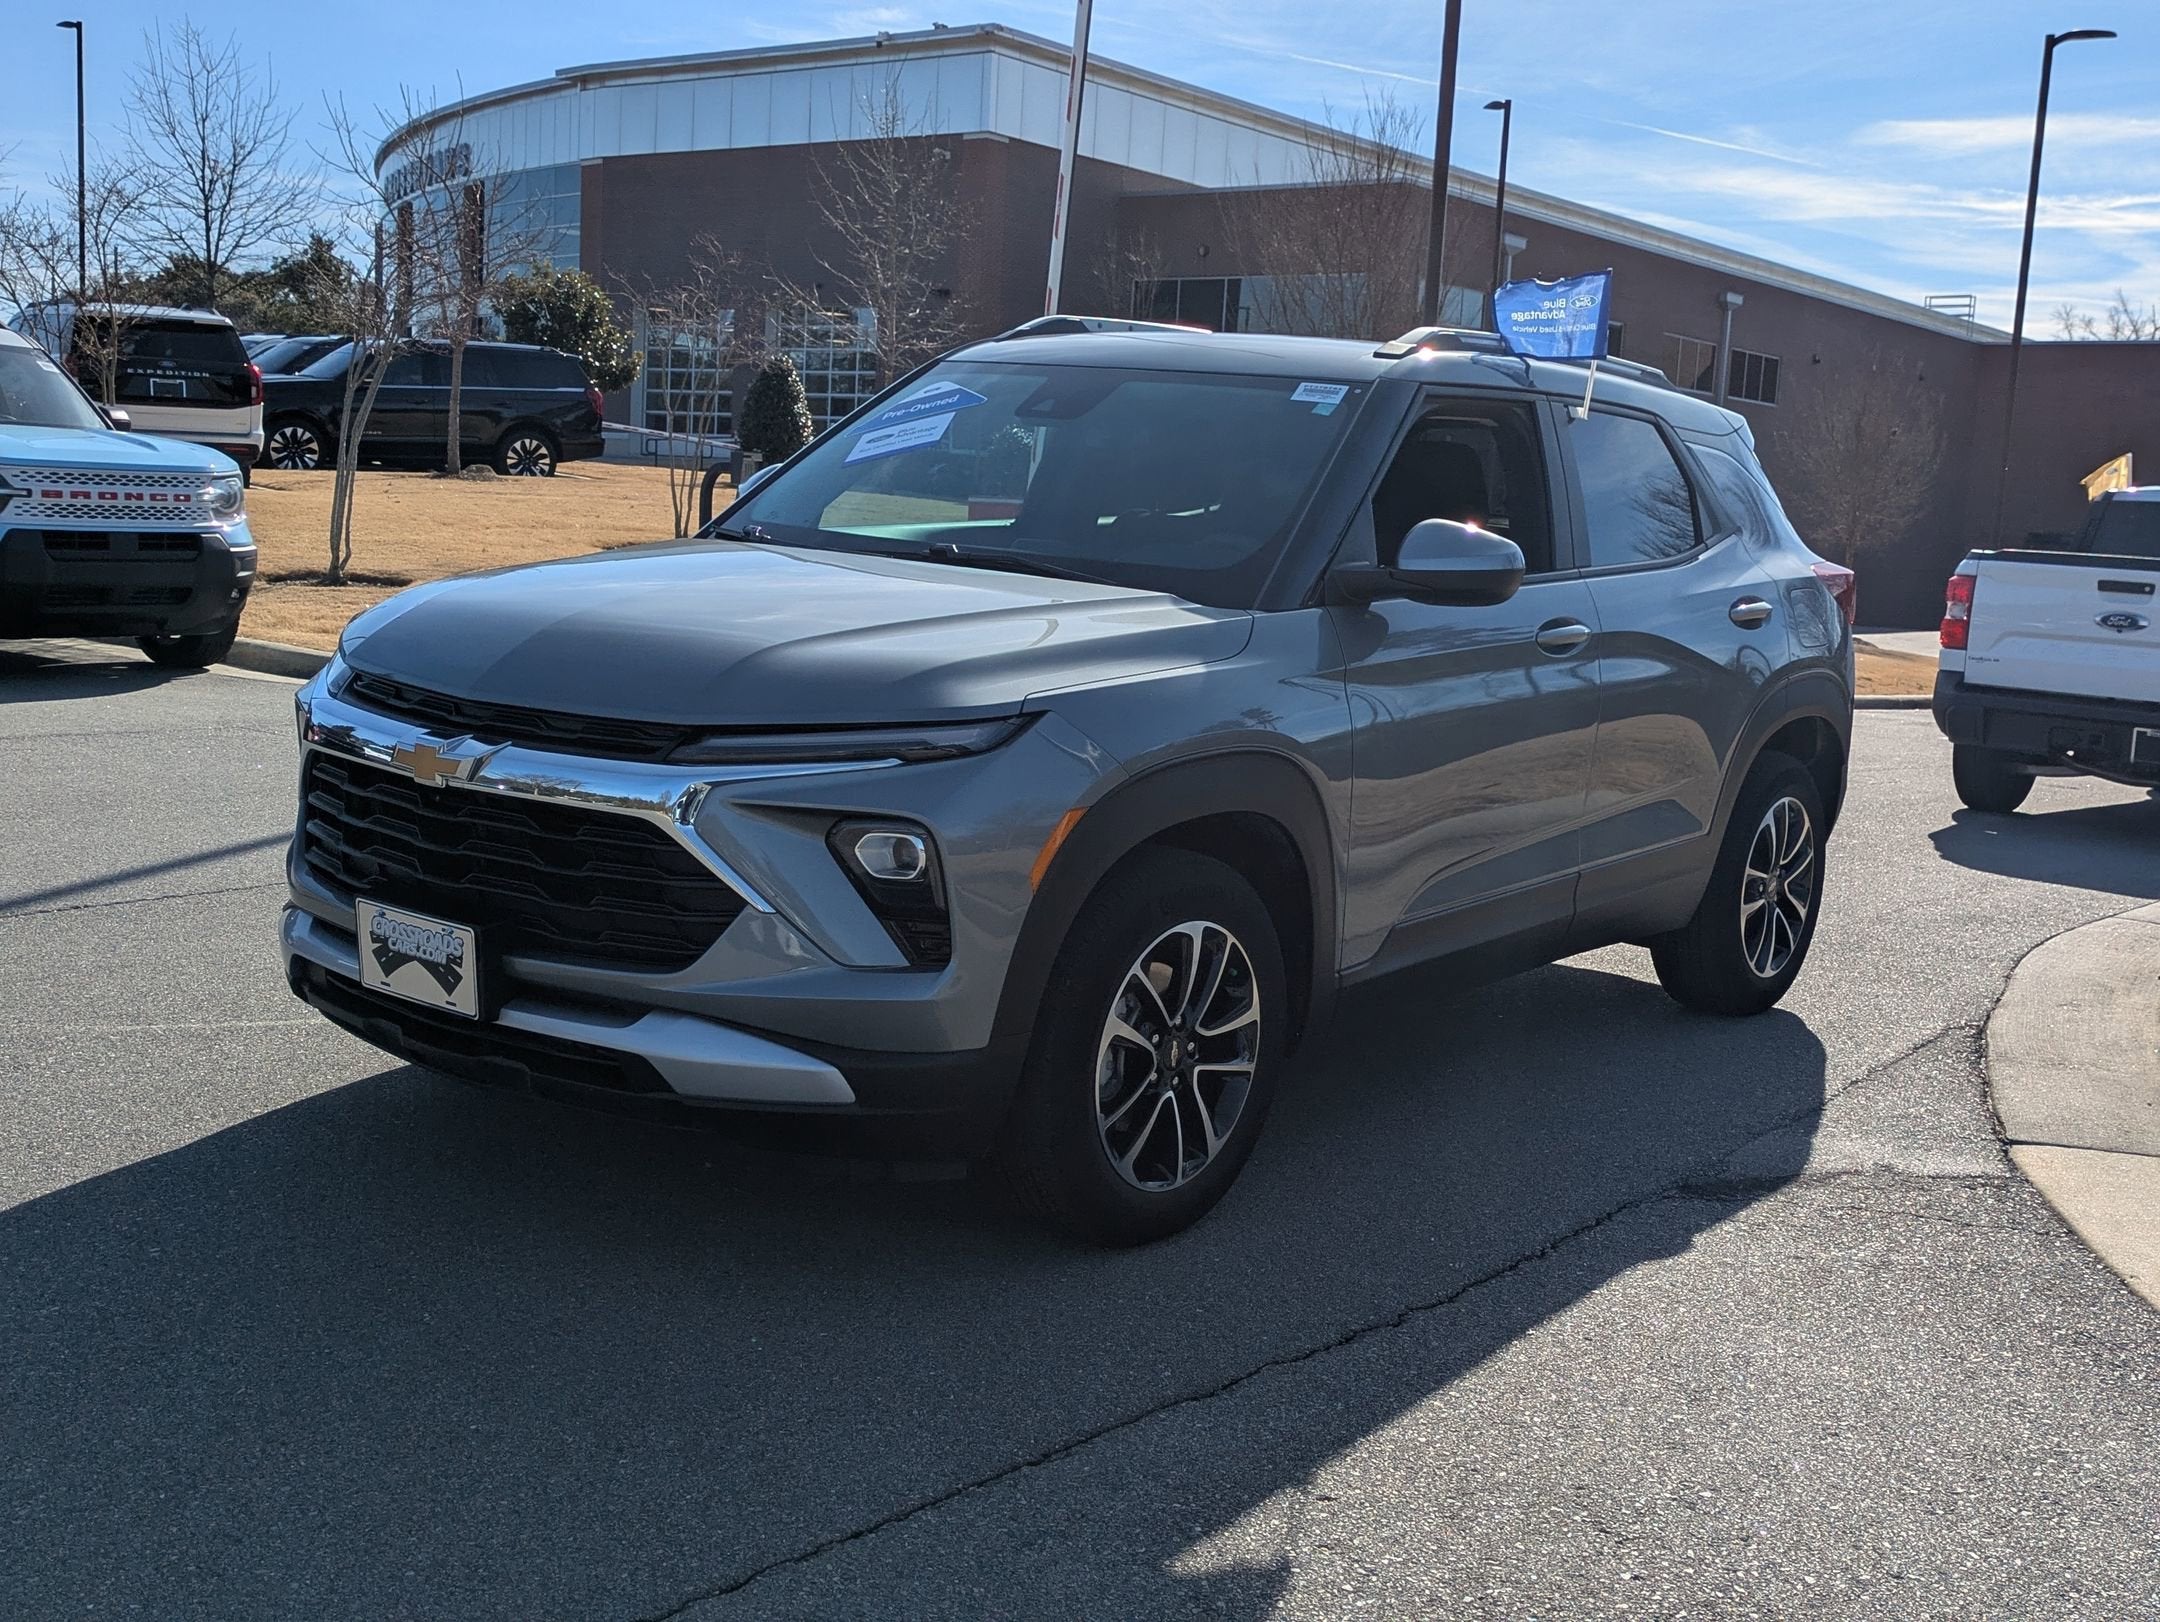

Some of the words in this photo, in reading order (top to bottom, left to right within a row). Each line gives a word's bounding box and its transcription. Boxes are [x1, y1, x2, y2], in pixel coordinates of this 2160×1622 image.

[127, 368, 210, 377] EXPEDITION
[881, 394, 960, 420] Pre-Owned
[41, 489, 191, 502] BRONCO
[371, 914, 464, 959] CROSSROADS
[387, 937, 448, 965] CARS.COM
